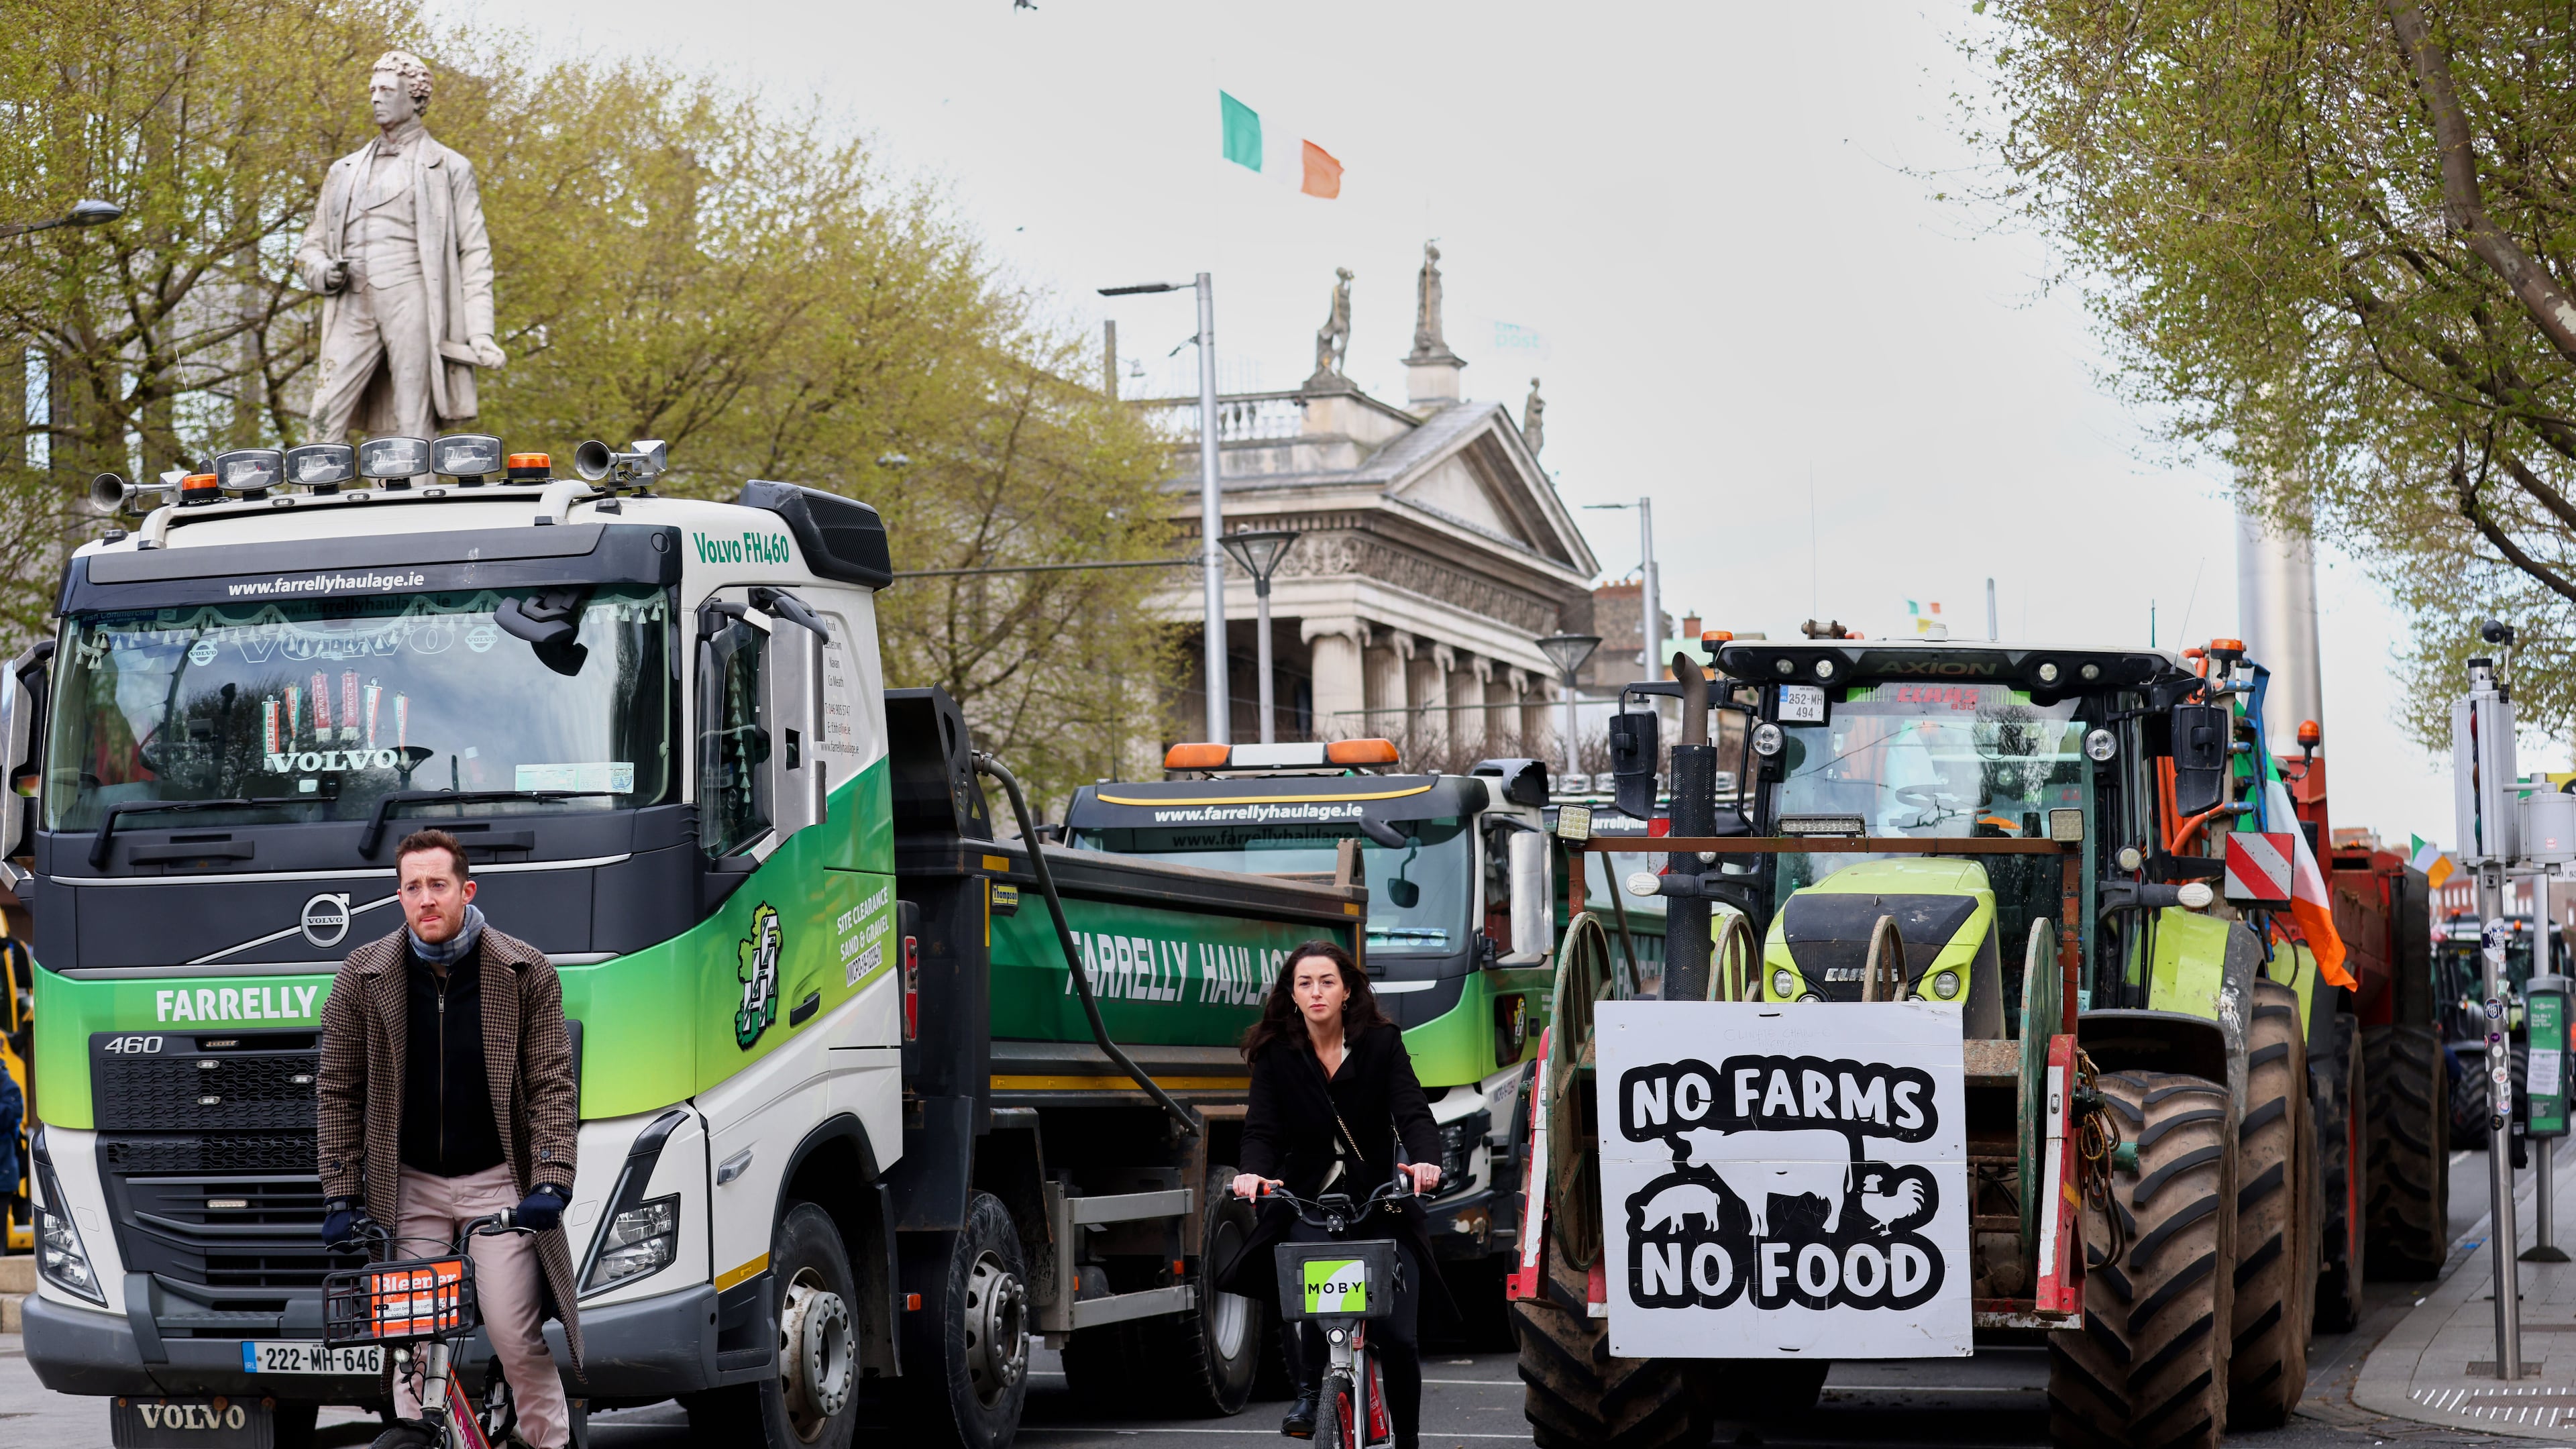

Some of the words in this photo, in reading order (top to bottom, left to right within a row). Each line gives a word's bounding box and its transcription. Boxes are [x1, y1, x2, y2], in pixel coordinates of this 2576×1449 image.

[743, 532, 790, 566] FH460
[228, 571, 425, 596] www.farrellyhaulage.ie
[466, 635, 497, 644] VOLVO
[190, 649, 217, 657] VOLVO
[828, 656, 841, 669] Navan
[1878, 661, 1996, 676] AXION
[833, 675, 845, 688] Meath
[315, 678, 326, 720] TRUCKER
[346, 676, 354, 718] TRUCKER
[1788, 693, 1823, 705] 252-MH
[1896, 686, 1980, 704] CLAAS
[1796, 706, 1813, 718] 494
[267, 710, 275, 752] IRELAND
[266, 749, 398, 773] VOLVO
[1155, 803, 1363, 822] www.farrellyhaulage.ie
[994, 885, 1018, 904] Thompson
[837, 910, 853, 936] SITE
[853, 885, 889, 925] CLEARANCE
[840, 934, 859, 962] SAND
[859, 930, 865, 949] &
[865, 914, 890, 944] GRAVEL
[1199, 943, 1292, 1006] HAULAG
[156, 985, 319, 1022] FARRELLY
[104, 1036, 164, 1055] 460
[1632, 1071, 1711, 1129] NO
[1734, 1068, 1926, 1130] FARMS
[1641, 1242, 1733, 1297] NO
[1761, 1242, 1931, 1299] FOOD
[376, 1273, 457, 1296] Bleeper
[1308, 1282, 1362, 1295] MOBY
[245, 1361, 256, 1369] IRL
[266, 1348, 379, 1373] 222-MH-646
[137, 1403, 246, 1430] VOLVO
